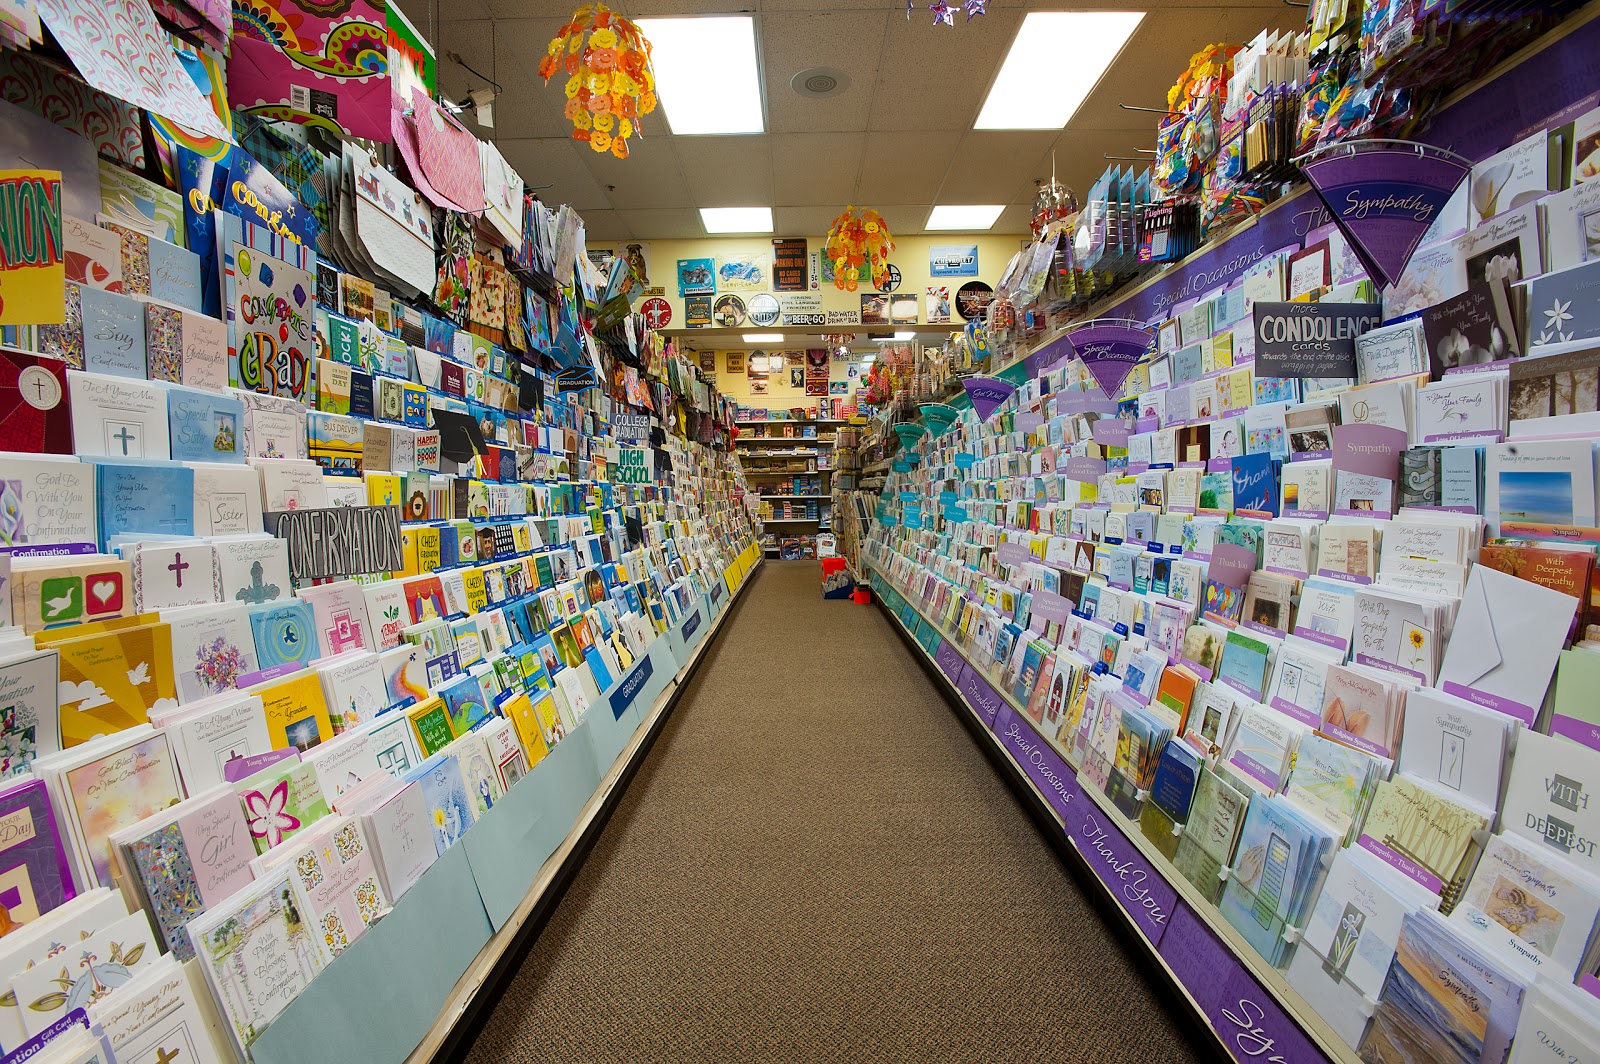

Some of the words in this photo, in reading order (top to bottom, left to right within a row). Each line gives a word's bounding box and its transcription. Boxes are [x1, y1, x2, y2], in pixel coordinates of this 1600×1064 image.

[1149, 207, 1173, 218] Lighting
[1343, 189, 1435, 222] Sympathy
[1467, 234, 1481, 246] You
[1489, 222, 1508, 240] Your
[1505, 213, 1528, 230] Family
[934, 257, 973, 265] CHEVROLET
[1153, 275, 1194, 315] Special
[1192, 245, 1265, 292] Occasions
[645, 298, 666, 307] FORD
[1290, 304, 1319, 314] more
[1429, 311, 1444, 322] With
[1442, 303, 1467, 318] Sympathy
[1472, 293, 1486, 305] You
[240, 293, 310, 342] CONGRATS
[792, 314, 809, 324] BEER
[812, 314, 825, 324] GO
[1457, 319, 1473, 332] Your
[1472, 311, 1491, 325] Family
[94, 319, 135, 350] Boy
[1260, 315, 1380, 344] CONDOLENCE
[1082, 342, 1115, 358] Special
[1291, 341, 1331, 351] cards
[1097, 351, 1140, 362] Occasions
[1261, 351, 1288, 361] towards
[1290, 351, 1301, 361] the
[1302, 351, 1315, 362] end
[1281, 361, 1314, 374] wrapping
[1374, 357, 1400, 375] Sympathy
[558, 379, 595, 387] GRADUATION
[1441, 398, 1459, 411] Your
[1458, 393, 1482, 406] Family
[175, 402, 210, 422] Special
[324, 422, 336, 432] BUS
[336, 423, 359, 435] DRIVER
[615, 414, 649, 428] COLLEGE
[177, 425, 208, 445] Sister
[619, 449, 645, 466] HIGH
[1347, 442, 1392, 456] Sympathy
[1498, 453, 1518, 463] Thinking
[35, 472, 61, 488] God
[62, 474, 80, 488] Be
[615, 465, 653, 485] SCHOOL
[1233, 463, 1271, 494] Thank
[26, 490, 59, 504] With
[60, 492, 83, 507] You
[37, 504, 55, 519] On
[55, 506, 83, 525] Your
[214, 502, 244, 524] Sister
[1303, 511, 1318, 519] Daughter
[26, 523, 87, 538] Confirmation
[1415, 528, 1443, 542] Sympathy
[1552, 527, 1582, 539] Sympathy
[277, 506, 402, 578] CONFIRMATION
[420, 535, 437, 548] CHEESY
[11, 547, 70, 558] Confirmation
[420, 550, 439, 559] GRADUATION
[1545, 556, 1565, 566] With
[423, 560, 438, 572] CARD
[1217, 557, 1237, 568] Thank
[1236, 560, 1248, 571] You
[1416, 564, 1446, 579] Sympathy
[1536, 564, 1574, 577] Deepest
[466, 577, 483, 590] CHEESY
[1330, 572, 1340, 580] Loss
[1348, 574, 1356, 582] Wife
[1531, 574, 1575, 589] Sympathy
[467, 590, 485, 600] GRADUATION
[471, 600, 486, 612] CARD
[1317, 601, 1337, 614] Wife
[1358, 598, 1376, 613] With
[1375, 603, 1390, 618] Deep
[1251, 622, 1260, 631] Loss
[1265, 626, 1277, 636] Brother
[1360, 616, 1389, 639] Sympathy
[1365, 657, 1388, 672] Religious
[622, 667, 646, 699] GRADUATION
[1230, 679, 1238, 687] Loss
[968, 679, 996, 718] Friendship
[1470, 692, 1499, 708] Sympathy
[1435, 716, 1473, 738] Sympathy
[1447, 713, 1463, 724] With
[1332, 728, 1354, 744] Religious
[1353, 736, 1377, 754] Sympathy
[98, 765, 114, 778] God
[114, 755, 133, 771] Bless
[132, 751, 147, 764] You
[246, 758, 263, 768] Young
[262, 754, 281, 764] Woman
[1004, 722, 1037, 757] Special
[1030, 749, 1074, 804] Occasions
[1247, 758, 1256, 768] Loss
[1255, 763, 1261, 771] Of
[1314, 758, 1327, 771] WITH
[1326, 764, 1342, 778] DEEP
[87, 784, 101, 796] On
[101, 776, 119, 792] Your
[119, 758, 161, 782] Confirmation
[1312, 769, 1337, 787] SYMPATHY
[1544, 777, 1591, 810] WITH
[0, 814, 21, 828] YOUR
[1, 820, 32, 844] Day
[1524, 812, 1598, 858] DEEPEST
[200, 821, 237, 865] Girl
[1082, 814, 1134, 881] Thank
[1123, 869, 1166, 925] You
[1368, 841, 1394, 862] Sympathy
[1397, 858, 1416, 876] Thank
[1416, 871, 1429, 884] You
[1520, 869, 1558, 898] Sympathy
[252, 936, 280, 960] Prayers
[1508, 938, 1543, 967] Sympathy
[253, 951, 287, 980] Blessings
[1460, 956, 1485, 973] MESSAGE
[1484, 970, 1493, 979] OF
[257, 970, 301, 1007] Confirmation
[1437, 970, 1481, 1013] Sympathy
[41, 1028, 56, 1041] Gift
[55, 1016, 72, 1031] Card
[1535, 1029, 1567, 1060] With
[8, 1043, 41, 1064] ation
